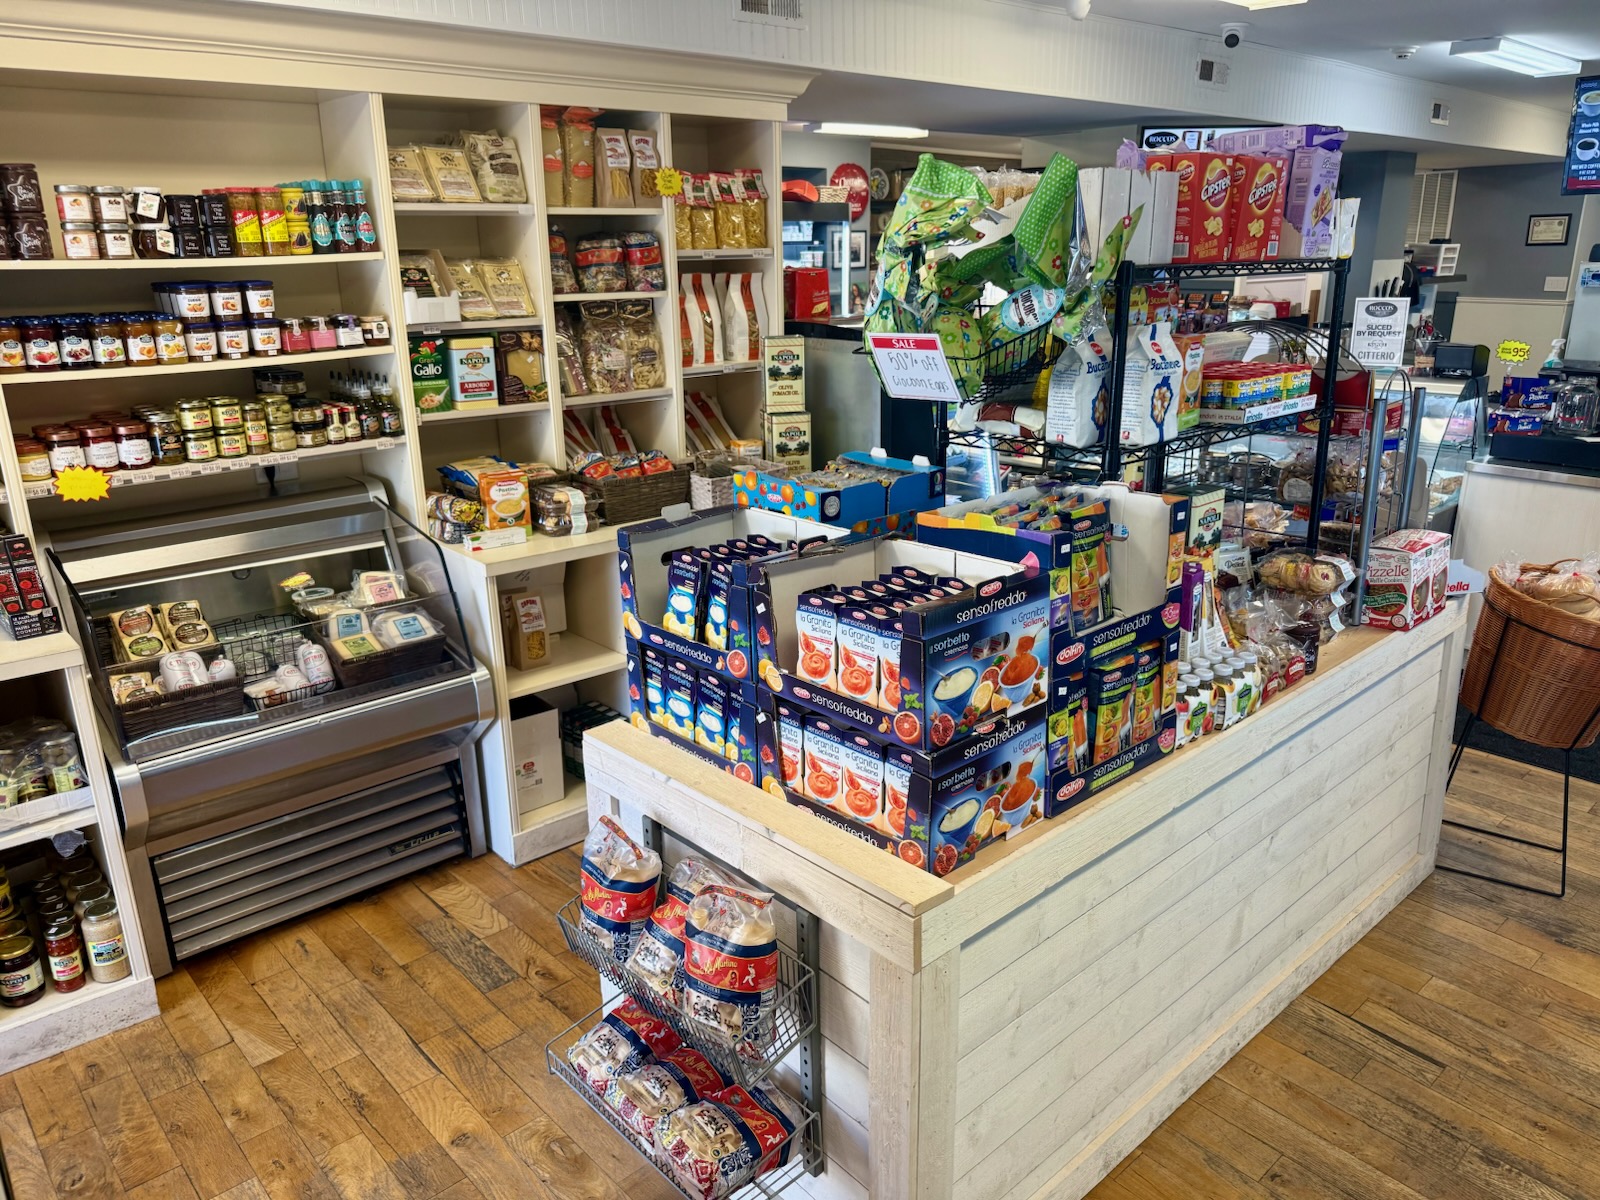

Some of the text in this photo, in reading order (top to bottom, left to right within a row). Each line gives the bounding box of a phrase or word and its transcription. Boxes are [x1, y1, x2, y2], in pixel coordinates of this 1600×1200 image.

[1201, 174, 1231, 202] CIPSTER
[1248, 178, 1278, 206] CIPSTER
[234, 213, 257, 226] Marconi
[261, 213, 283, 226] Marconi
[1368, 304, 1394, 312] ROCCOS
[1367, 330, 1402, 338] REQUEST
[892, 338, 917, 349] SALE
[773, 353, 799, 361] NAPOLI
[887, 351, 940, 372] 50% off
[1357, 350, 1395, 361] CITTERIO
[413, 363, 442, 376] Gallo
[463, 381, 490, 389] ARBORIO
[1199, 413, 1218, 421] enduti
[781, 430, 807, 438] NAPOLI
[1199, 513, 1221, 526] NAPOLI
[799, 604, 833, 617] sensofreddo
[956, 590, 1023, 625] sensofreddo
[1017, 606, 1045, 623] Granita
[806, 614, 832, 629] Granita
[841, 617, 877, 632] sensofreddo
[811, 624, 832, 636] Siciliana
[848, 626, 876, 645] Granita
[1093, 615, 1149, 646] sensofreddo
[852, 638, 875, 653] Siciliana
[933, 632, 971, 654] sorbetto
[663, 639, 713, 665] sensofreddo
[1058, 645, 1084, 662] dolfin
[811, 693, 874, 725] sensofreddo
[806, 724, 841, 743] sensofreddo
[963, 719, 1024, 760] sensofreddo
[1018, 731, 1042, 751] Granita
[813, 734, 840, 754] Granita
[844, 740, 880, 760] sensofreddo
[817, 745, 840, 761] Siciliana
[851, 751, 879, 771] Granita
[1093, 744, 1149, 779] sensofreddo
[855, 762, 879, 778] Siciliana
[941, 766, 976, 790] sorbetto
[1057, 781, 1085, 798] dolfin
[713, 957, 738, 970] Martino
